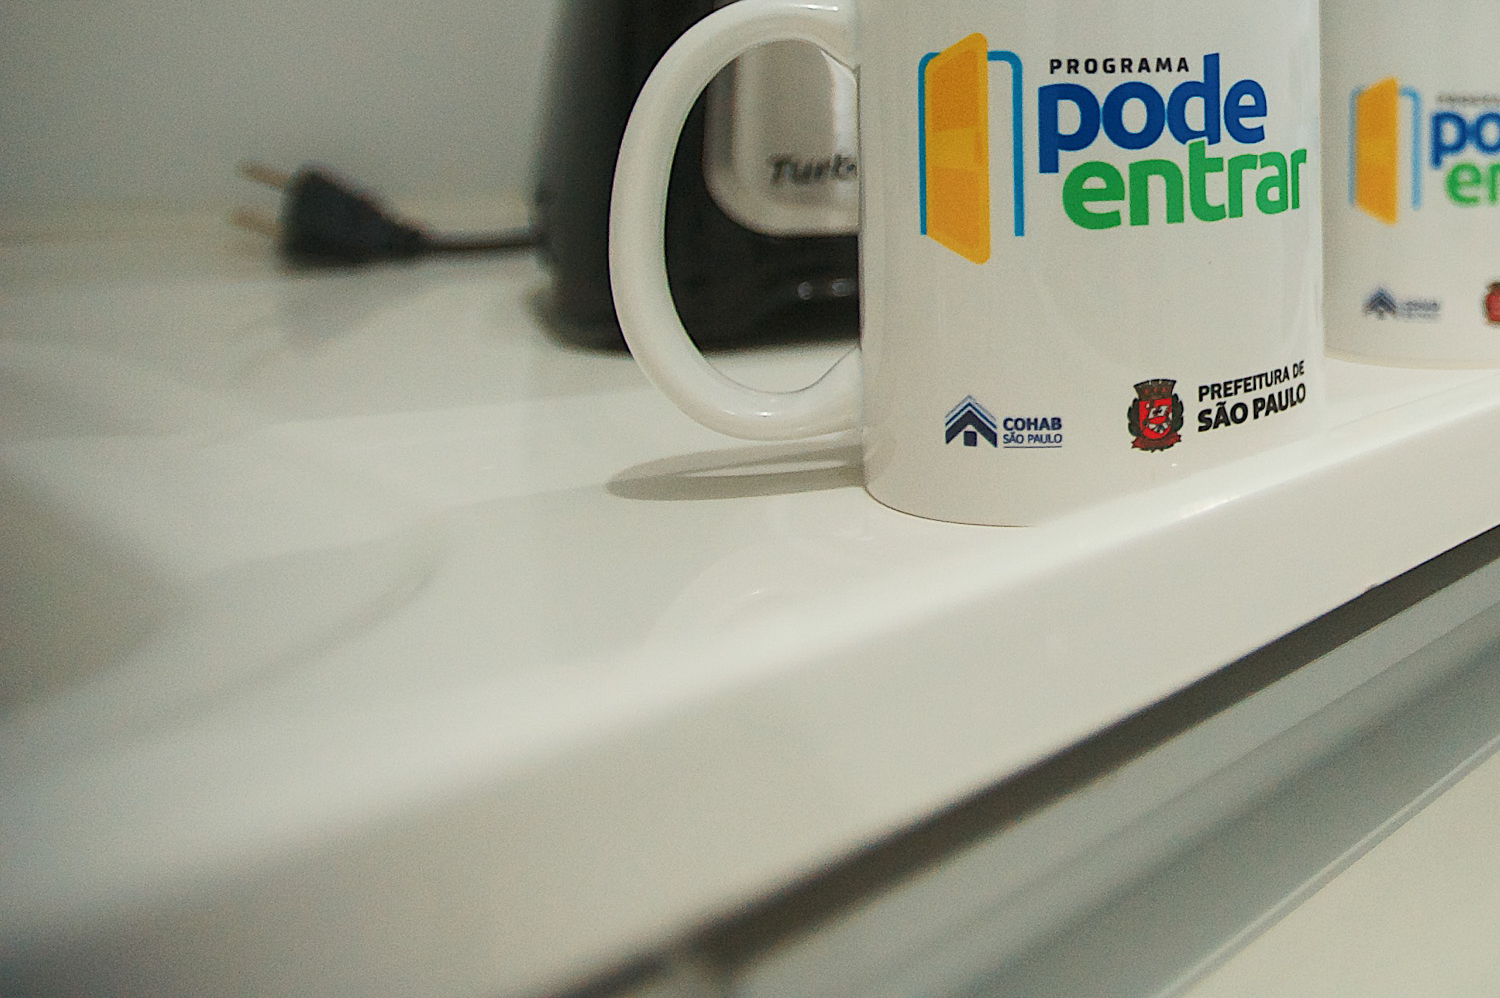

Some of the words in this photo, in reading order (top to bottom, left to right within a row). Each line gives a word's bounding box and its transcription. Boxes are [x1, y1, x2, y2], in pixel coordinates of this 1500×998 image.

[1049, 57, 1190, 74] PROGRAMA
[1038, 52, 1268, 174] pode
[766, 154, 858, 186] Turb
[1062, 139, 1307, 230] entrar
[1198, 366, 1290, 402] PREFEITURA
[1292, 360, 1305, 379] DE
[1003, 417, 1062, 431] COHAB
[1197, 401, 1249, 433] SÃO
[1252, 383, 1306, 420] PAULO
[1003, 431, 1024, 444] SÃO
[1027, 433, 1062, 444] PAULO
